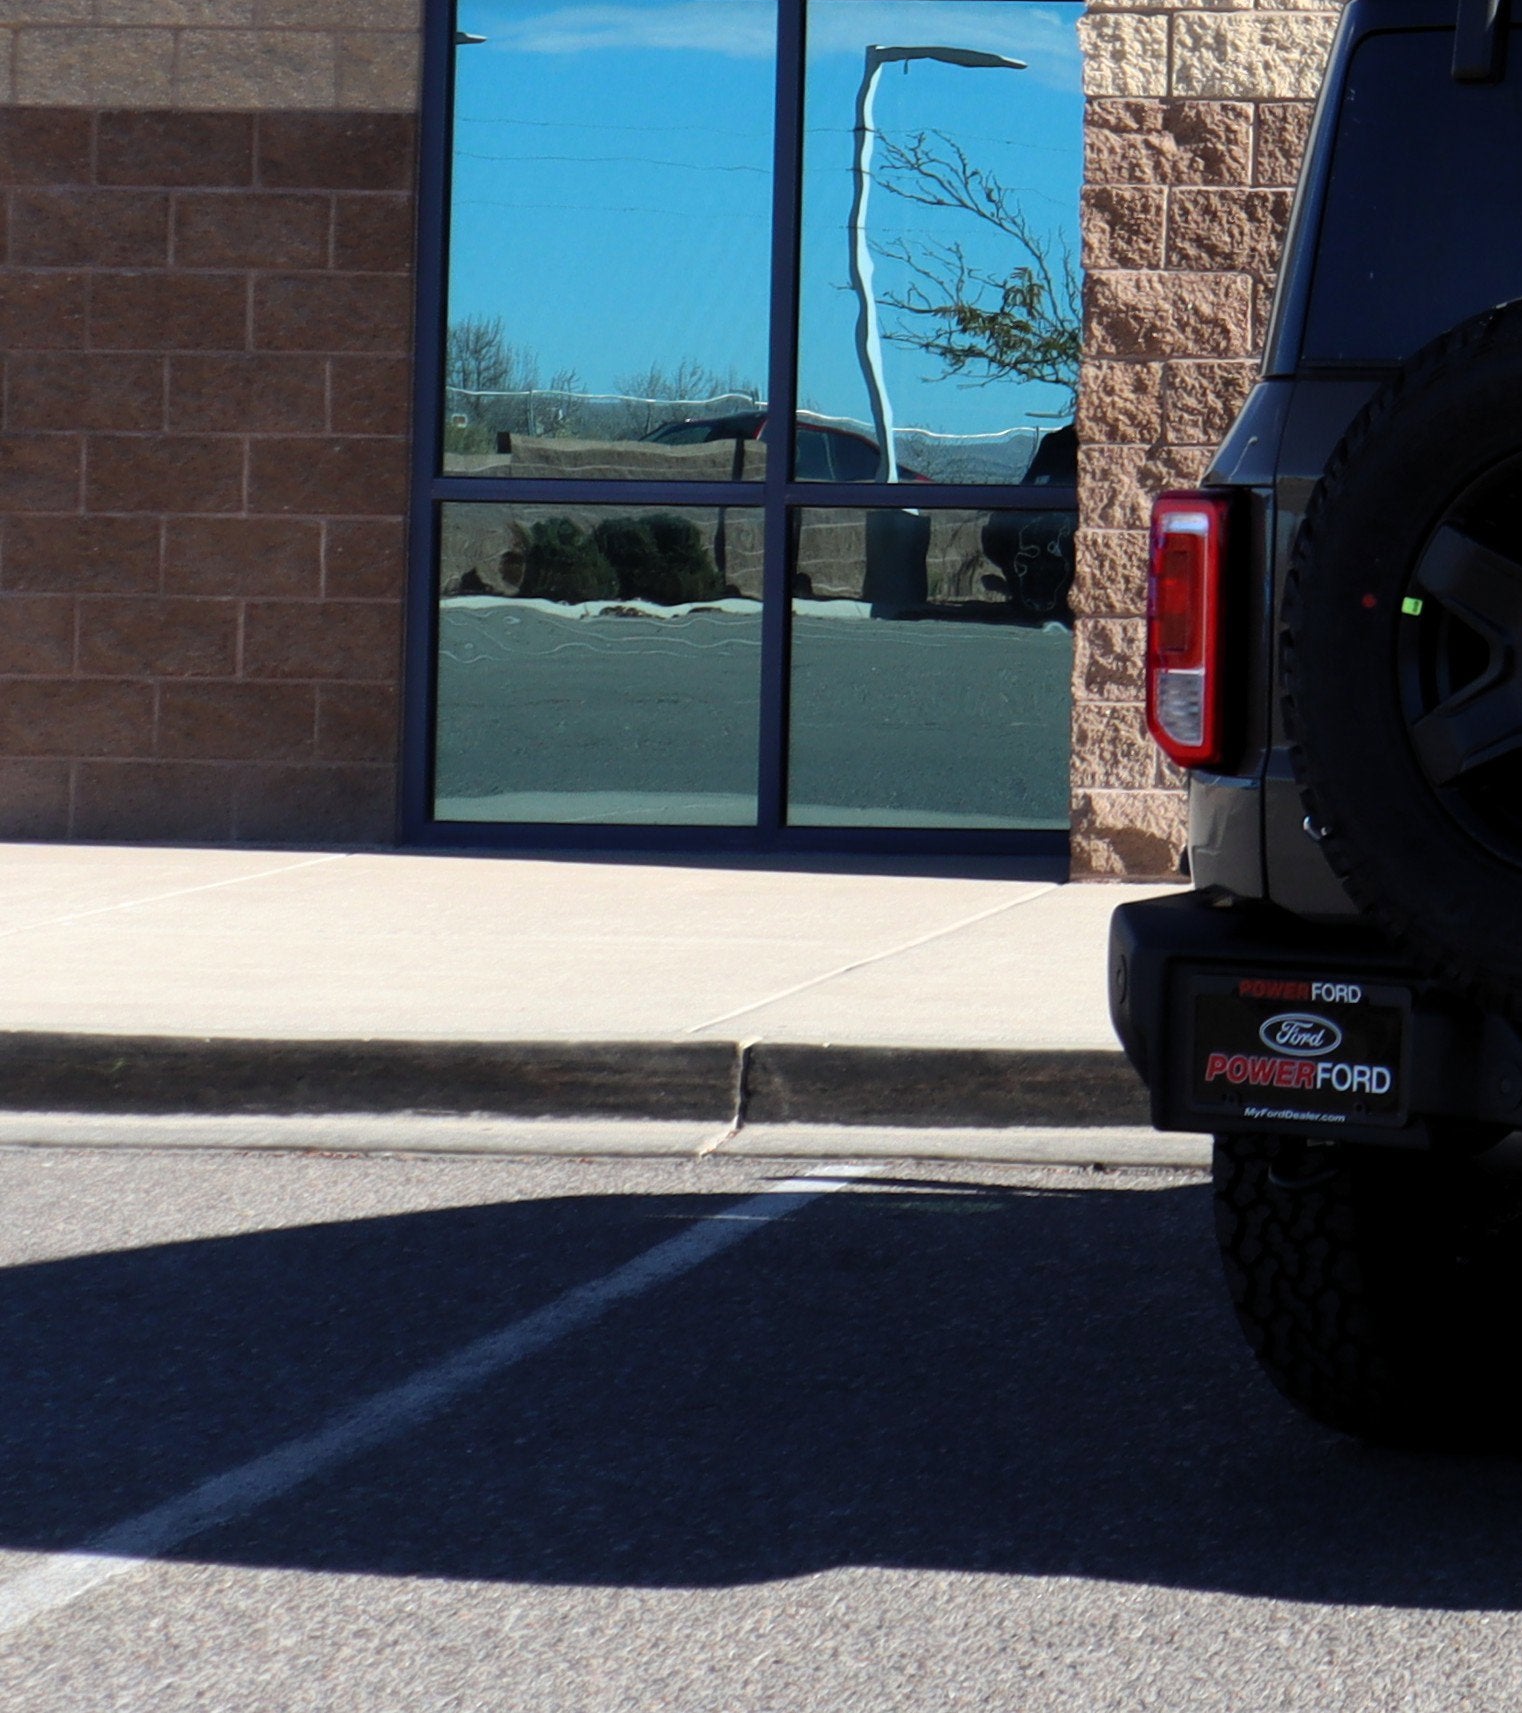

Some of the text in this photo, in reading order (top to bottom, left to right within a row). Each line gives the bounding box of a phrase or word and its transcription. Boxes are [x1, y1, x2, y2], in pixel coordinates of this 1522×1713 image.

[1239, 979, 1362, 1004] POWERFORD
[1276, 1021, 1325, 1047] Ford
[1205, 1053, 1391, 1094] POWERFORD
[1243, 1106, 1346, 1124] MyFordDealer.com
